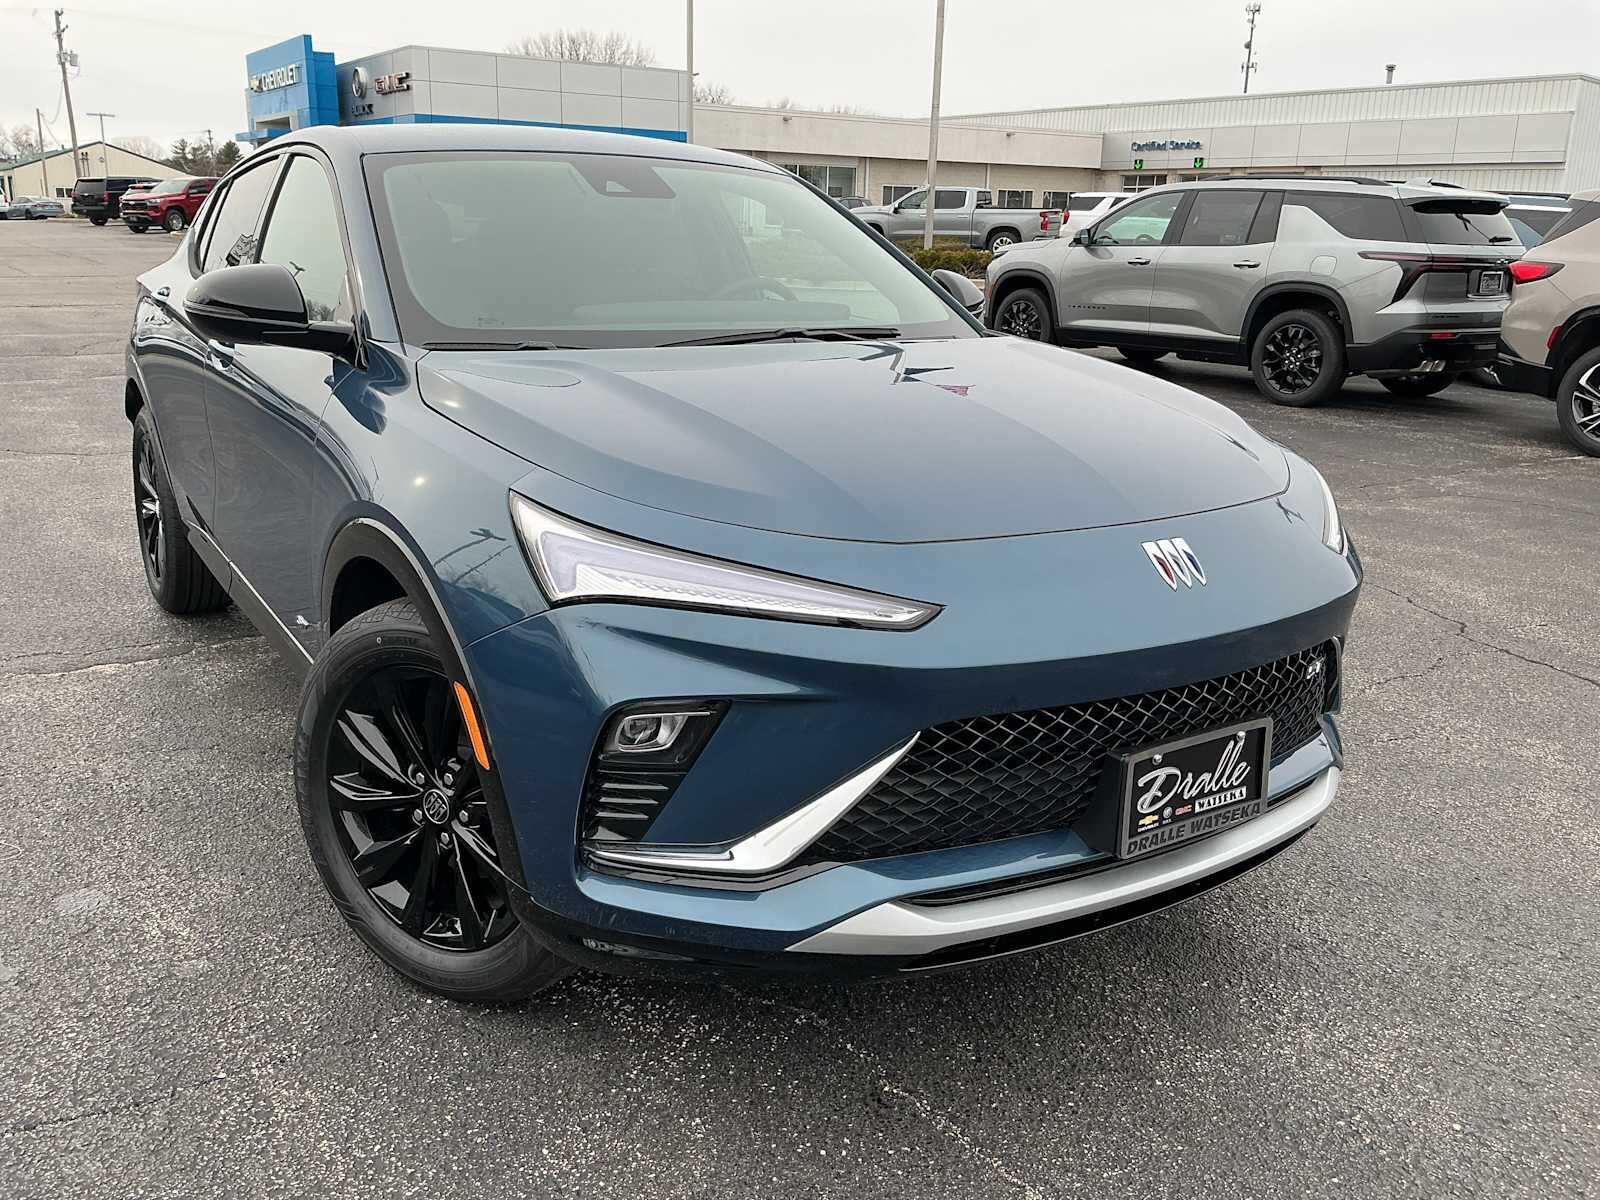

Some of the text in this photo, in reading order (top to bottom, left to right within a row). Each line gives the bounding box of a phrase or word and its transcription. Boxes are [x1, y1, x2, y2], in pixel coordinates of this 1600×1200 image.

[262, 63, 297, 91] CHEVROLET
[375, 72, 408, 94] GMC
[1131, 139, 1202, 152] Certified Service
[1137, 738, 1250, 814] Dralle
[1196, 787, 1246, 812] WATSEKA
[1127, 802, 1261, 855] DRALLE WATSEKA
